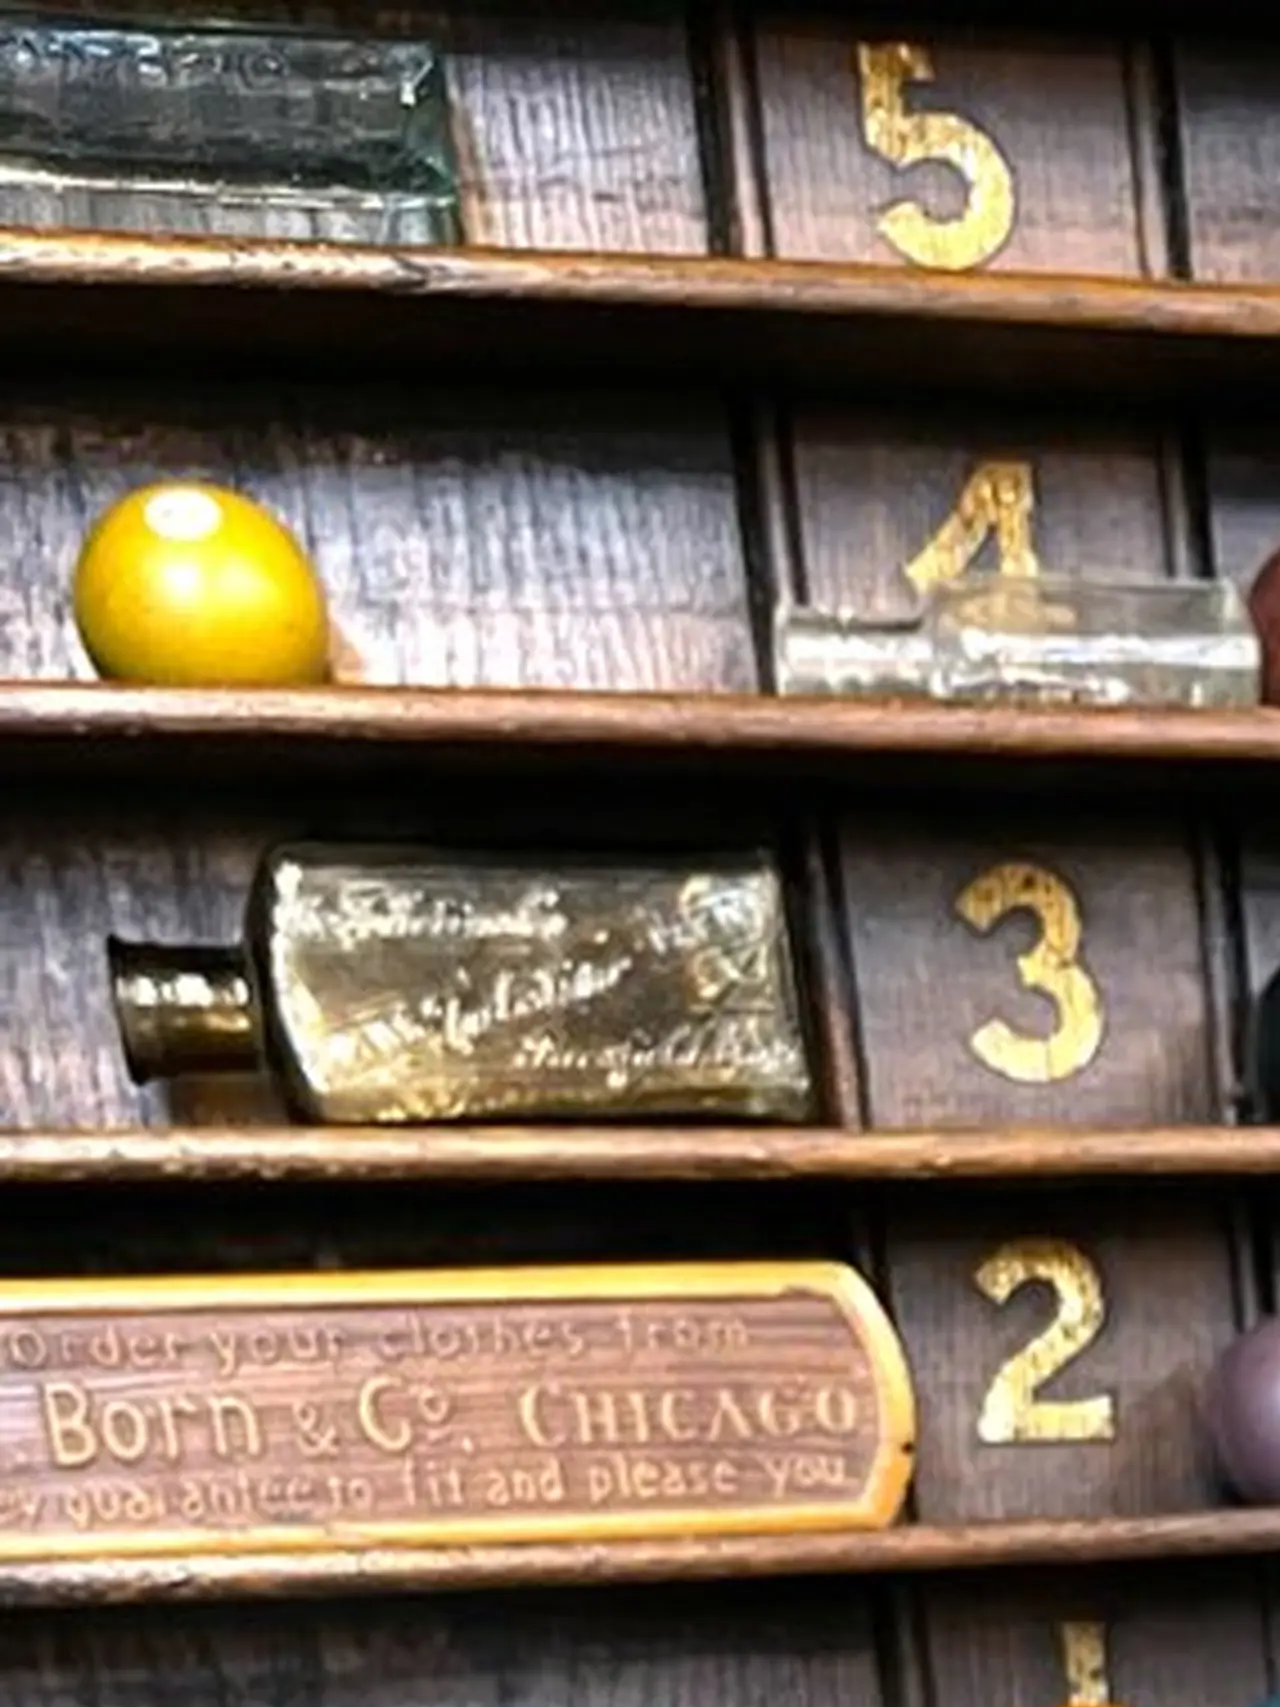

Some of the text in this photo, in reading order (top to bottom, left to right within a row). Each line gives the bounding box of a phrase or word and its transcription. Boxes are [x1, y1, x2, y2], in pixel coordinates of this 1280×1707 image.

[855, 40, 1014, 271] 5
[957, 862, 1101, 1083] 3
[208, 1324, 344, 1376] your
[975, 1238, 1114, 1443] 2
[44, 1375, 262, 1467] Born
[292, 1400, 342, 1457] &
[486, 1459, 564, 1507] and
[588, 1450, 740, 1502] please
